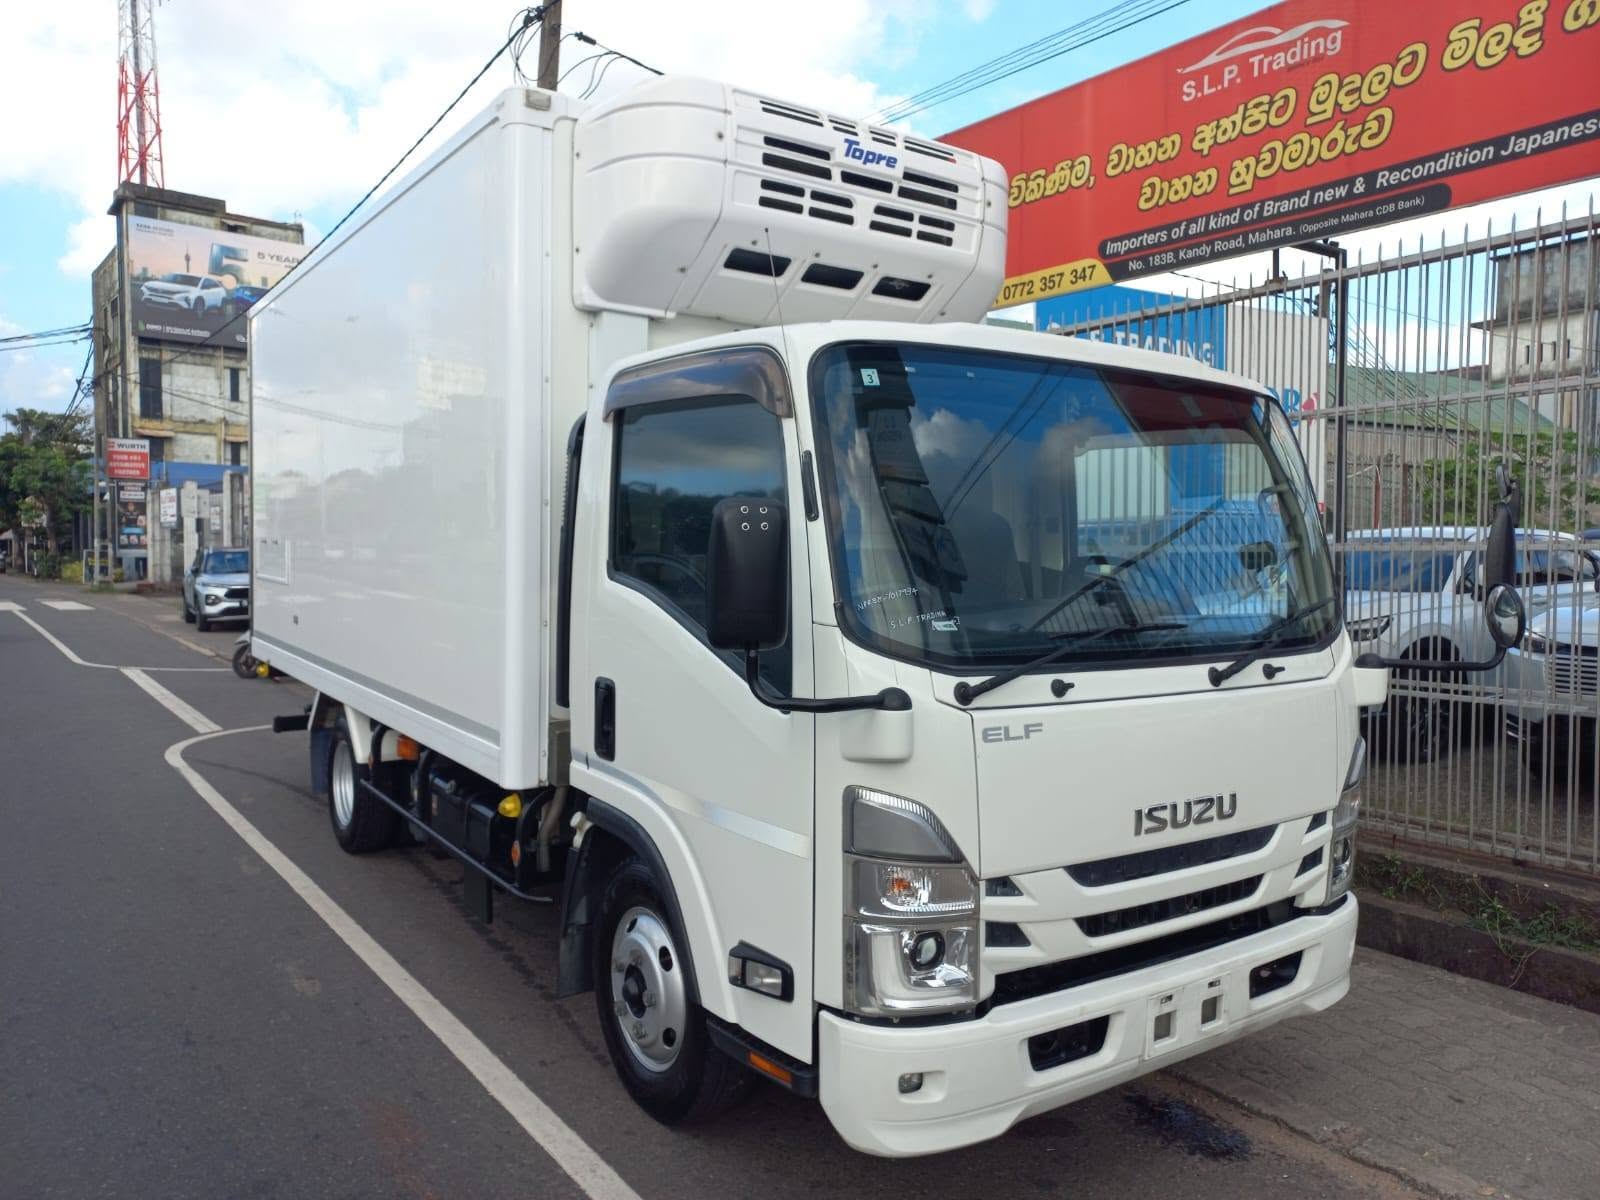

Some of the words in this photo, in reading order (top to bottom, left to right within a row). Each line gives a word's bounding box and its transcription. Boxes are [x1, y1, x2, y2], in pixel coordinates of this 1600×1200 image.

[1182, 63, 1241, 102] S.L.P.
[1248, 29, 1343, 78] Trading
[1105, 133, 1181, 177] වාහන
[1305, 42, 1428, 127] මුදලට
[843, 138, 898, 169] Topre
[1105, 228, 1168, 256] Importers
[1171, 223, 1186, 240] of
[1188, 216, 1206, 235] all
[1208, 208, 1239, 231] kind
[1243, 204, 1260, 222] of
[1263, 189, 1309, 217] Brand
[1313, 184, 1350, 205] new
[1353, 176, 1366, 194] &
[1376, 144, 1494, 189] Recondition
[1138, 166, 1218, 211] වාහන
[1128, 259, 1146, 272] No.
[1148, 250, 1176, 268] 183B,
[1179, 243, 1212, 262] Kandy
[1214, 236, 1246, 253] Road,
[1248, 225, 1297, 245] Mahara.
[1299, 217, 1340, 235] (Opposite
[1341, 208, 1374, 224] Mahara
[1376, 202, 1396, 217] CDB
[1398, 195, 1426, 211] Bank)
[209, 242, 249, 289] 5
[1003, 280, 1034, 301] 0772
[1040, 272, 1065, 292] 357
[1070, 264, 1097, 285] 347
[866, 374, 874, 384] 3
[982, 722, 1044, 744] ELF
[1134, 792, 1238, 837] ISUZU
